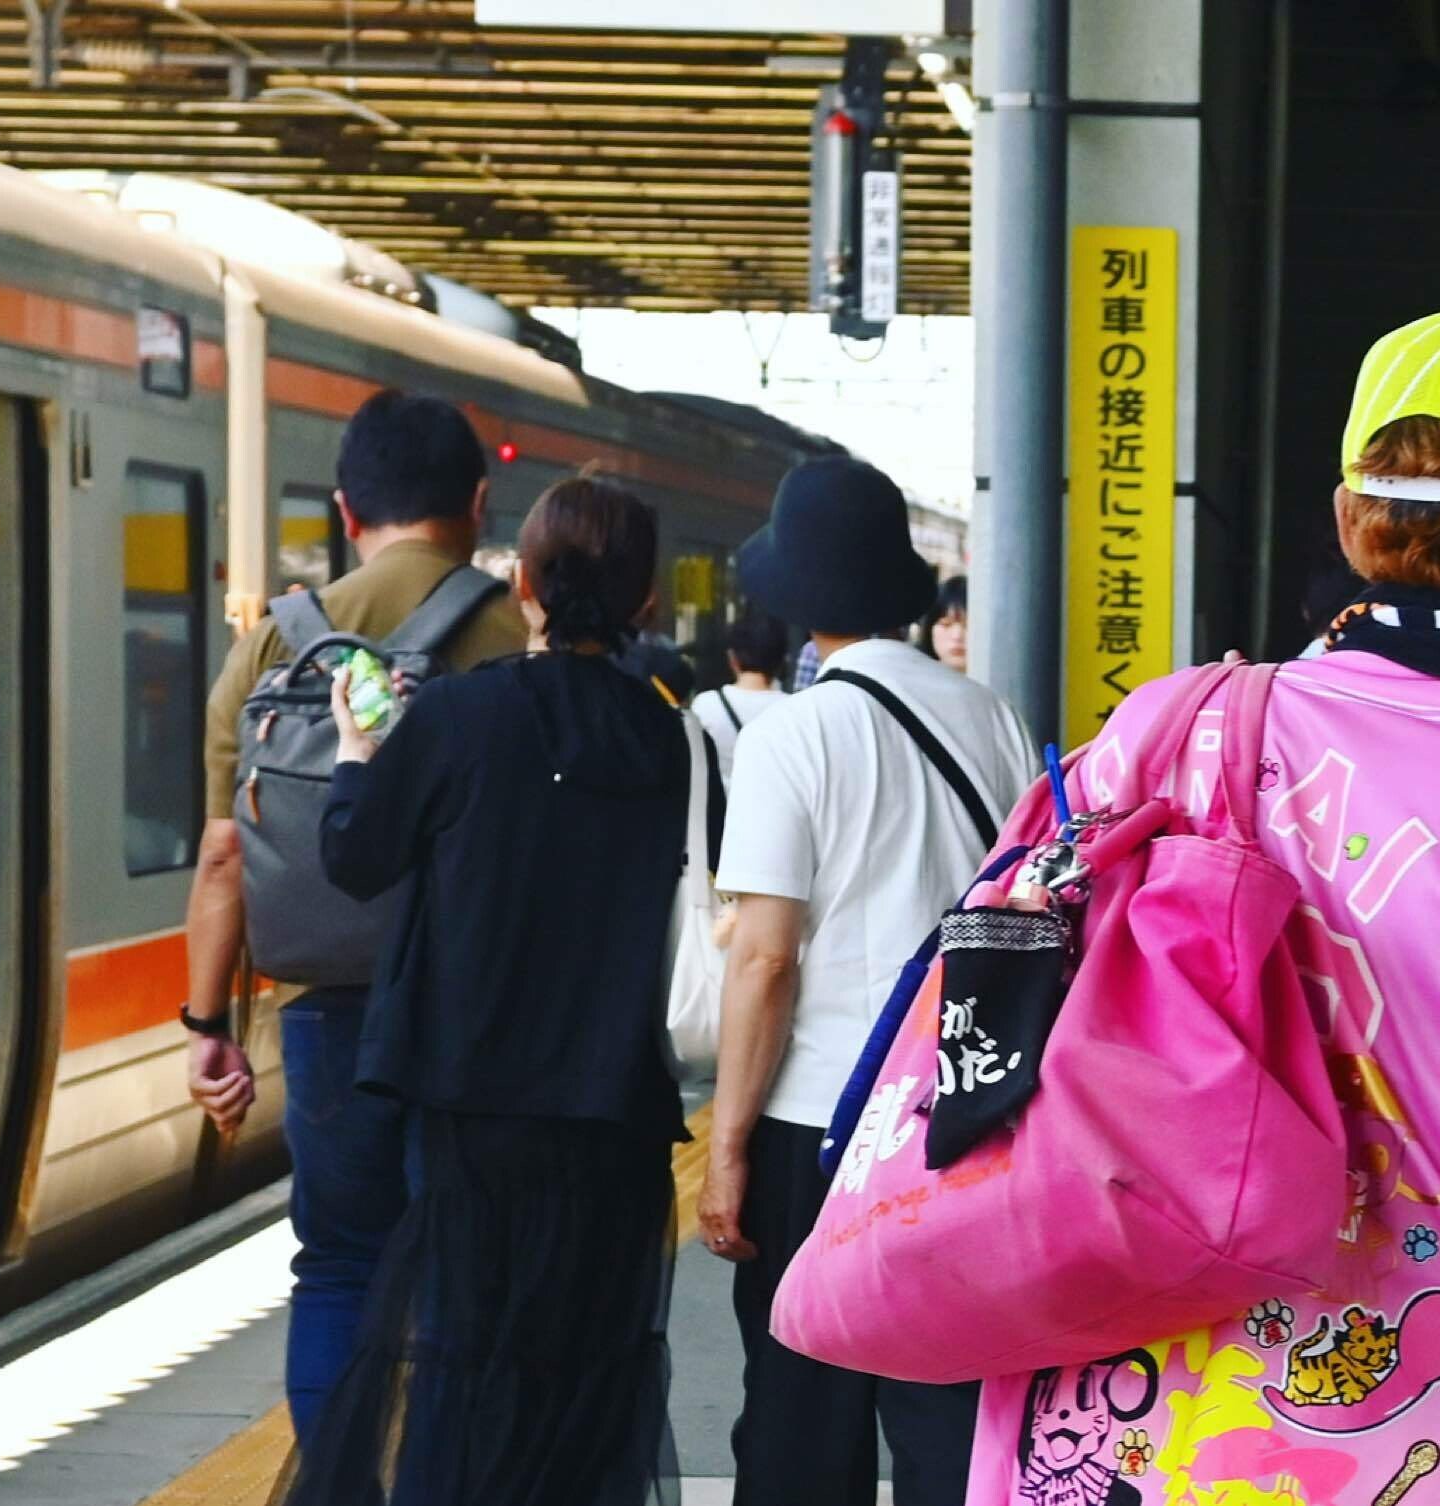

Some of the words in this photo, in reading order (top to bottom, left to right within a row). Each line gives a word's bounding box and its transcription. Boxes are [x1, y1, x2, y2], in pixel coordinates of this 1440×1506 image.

[1096, 247, 1148, 722] 列車の接近にご注意く
